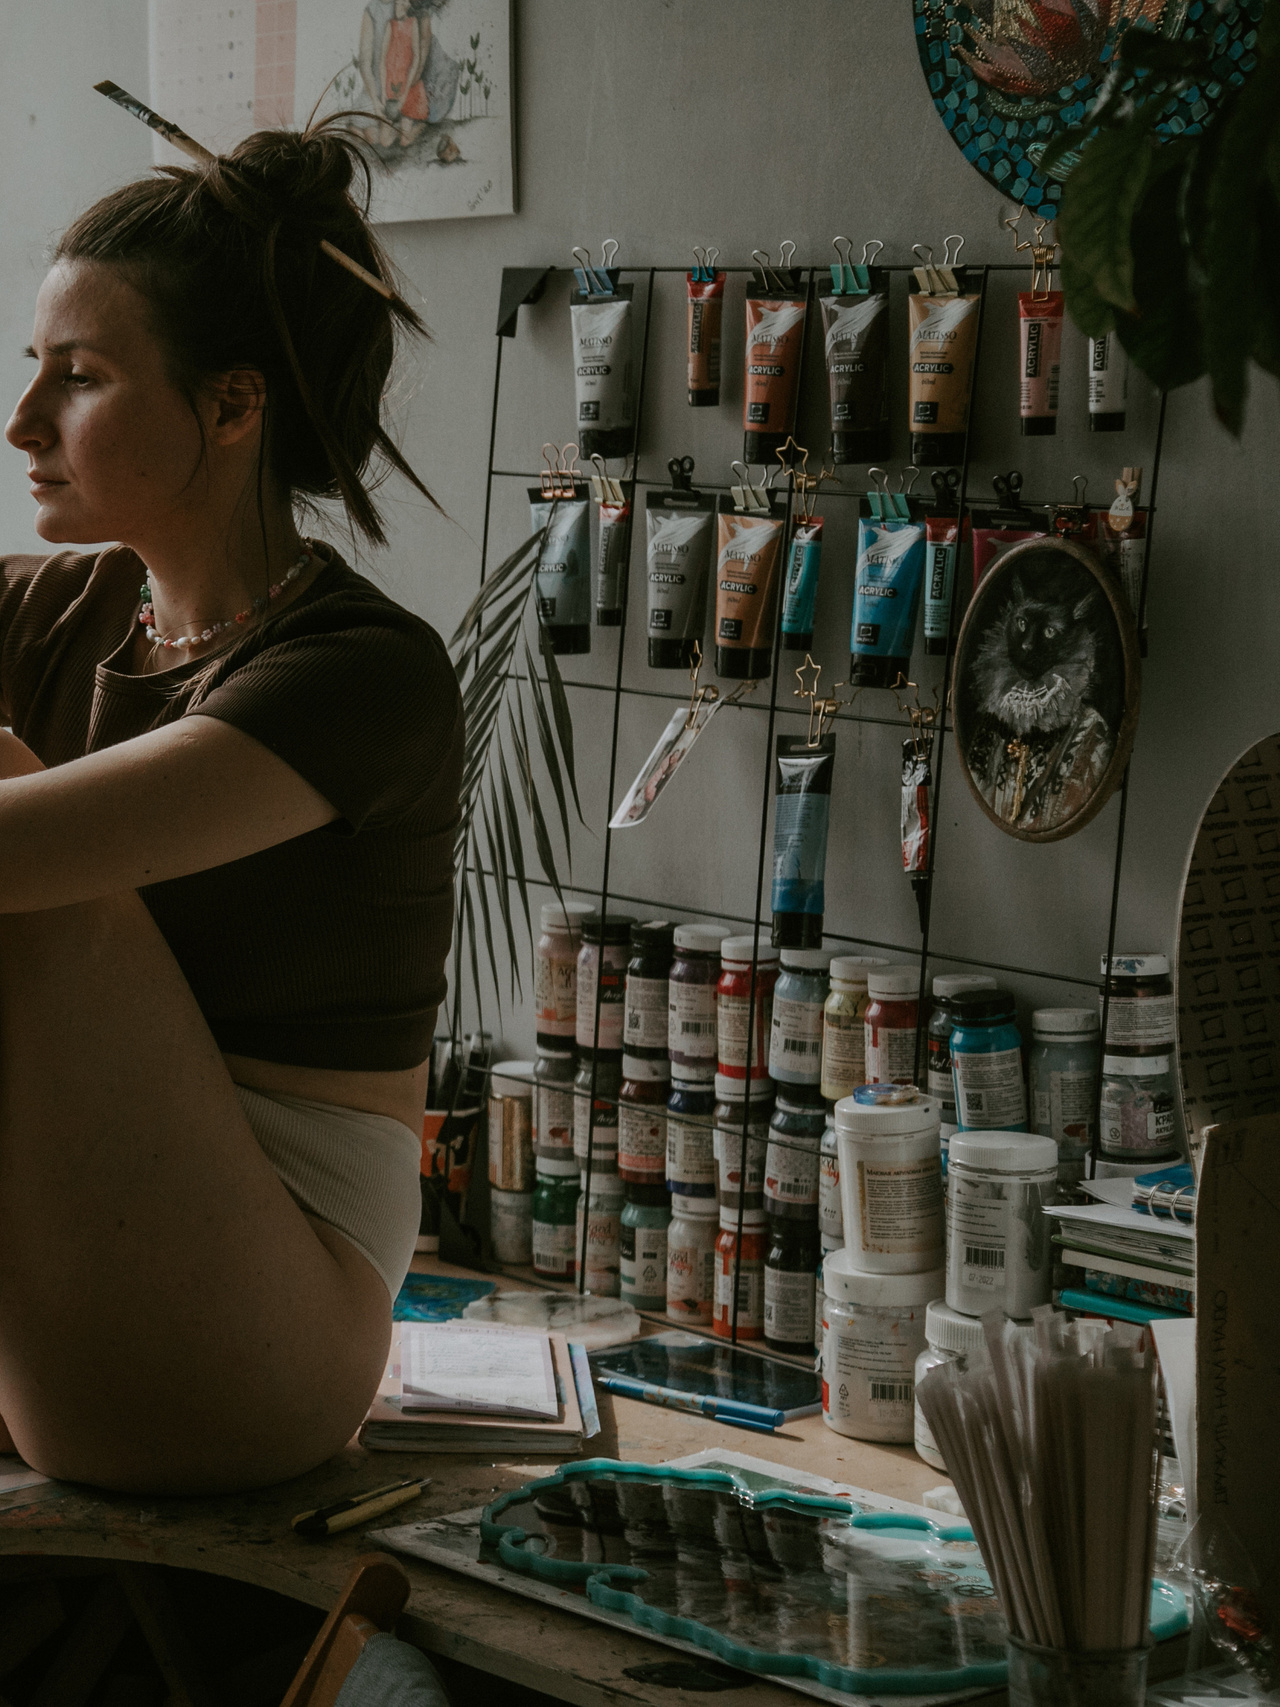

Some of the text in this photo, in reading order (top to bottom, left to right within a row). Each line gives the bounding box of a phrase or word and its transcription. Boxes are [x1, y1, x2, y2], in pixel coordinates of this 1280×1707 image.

[692, 304, 701, 352] ACRYLIC
[752, 333, 789, 343] MATISSO
[918, 330, 957, 340] MATISSO
[580, 336, 612, 347] MATISSO
[1027, 325, 1038, 375] ACRYLIC
[1095, 338, 1105, 369] ACRY
[578, 366, 607, 376] ACRYLIC
[749, 366, 781, 375] ACRYLIC
[830, 364, 865, 373] ACRYLIC
[914, 363, 949, 372] ACRYLIC
[653, 543, 690, 554] MATISSO
[725, 551, 761, 563] MATISSO
[538, 563, 563, 572] CRYLIC
[790, 548, 804, 593] ACRYLIC
[650, 574, 682, 583] ACRYLIC
[932, 550, 946, 598] ACRYLIC
[720, 581, 754, 593] ACRYLIC
[858, 586, 894, 597] ACRYLIC
[1212, 1290, 1228, 1352] НАДО
[1212, 1361, 1228, 1409] НАМ
